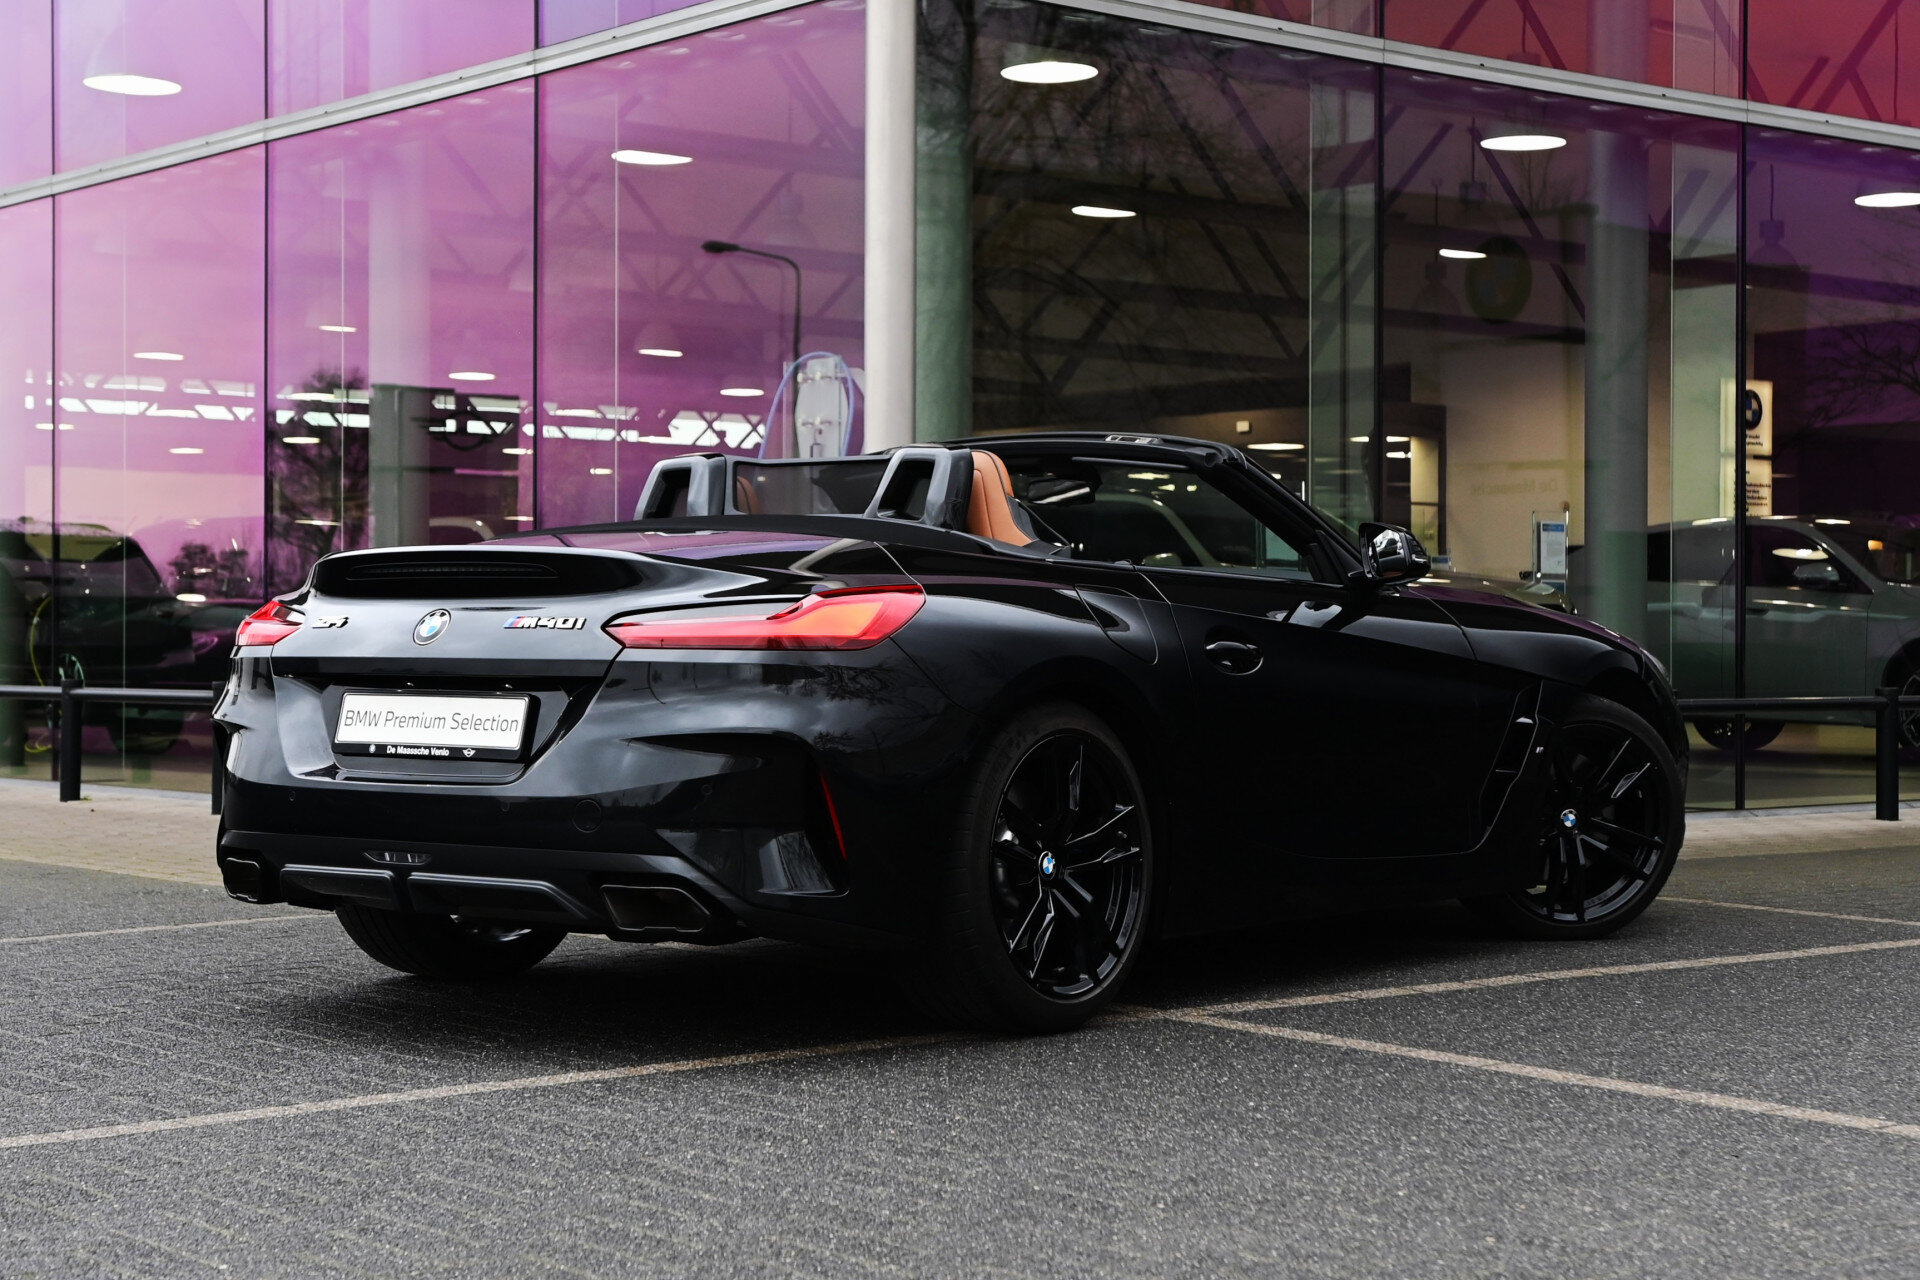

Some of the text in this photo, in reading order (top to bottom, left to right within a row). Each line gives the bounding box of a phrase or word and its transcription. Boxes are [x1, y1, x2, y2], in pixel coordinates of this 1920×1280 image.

[344, 709, 519, 733] BMW Premium Selection
[386, 745, 450, 757] De Maassche Venlo
